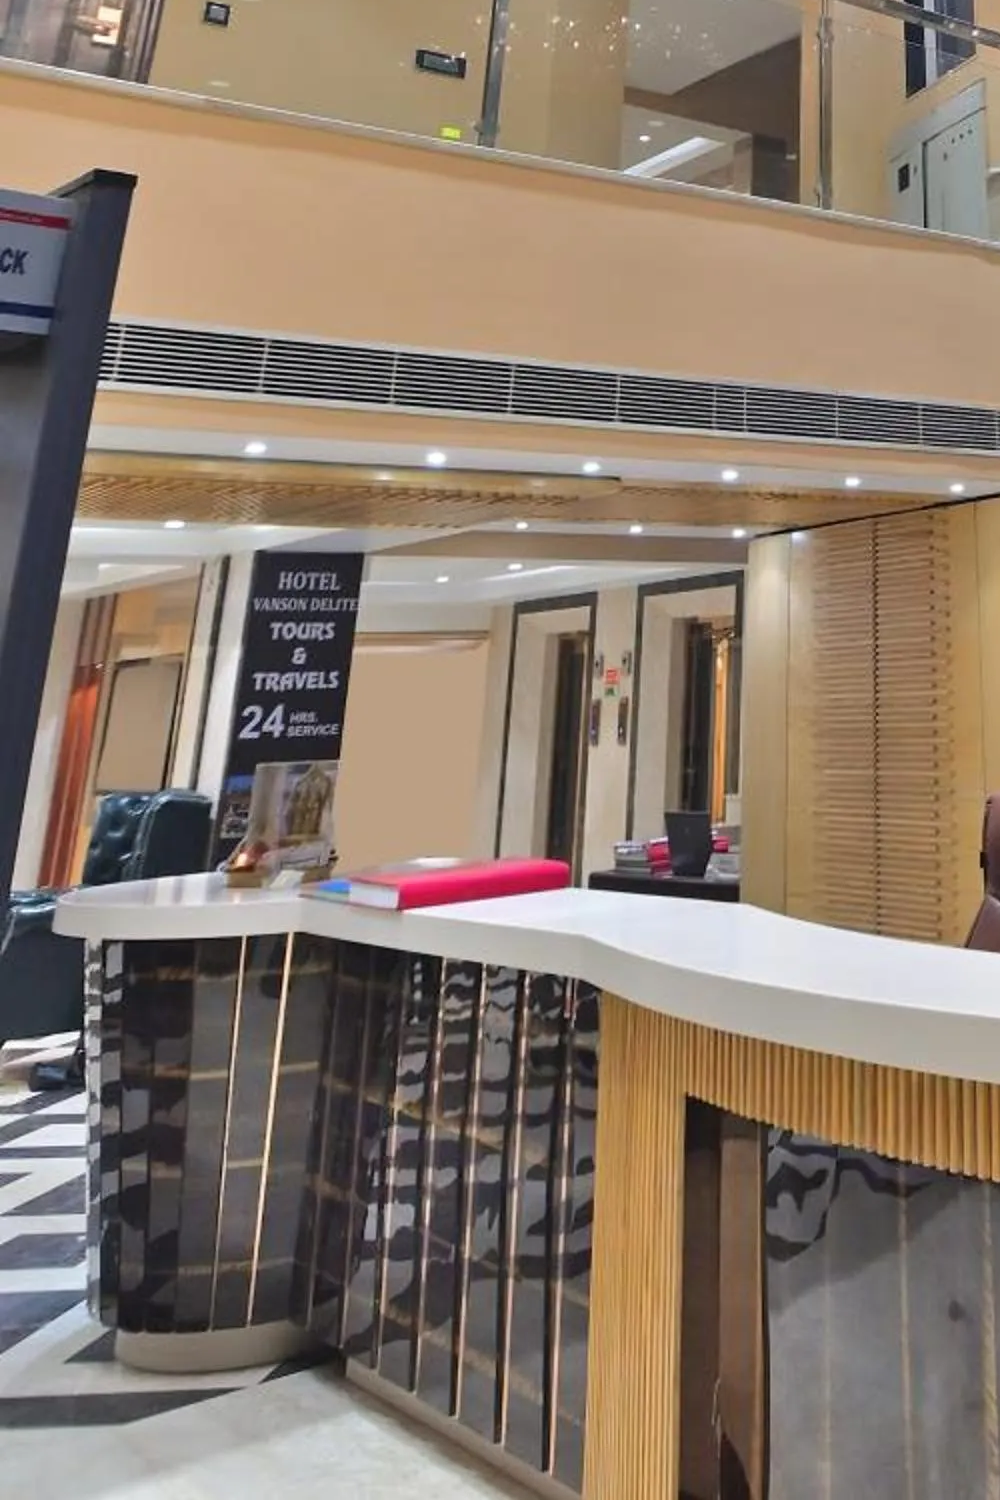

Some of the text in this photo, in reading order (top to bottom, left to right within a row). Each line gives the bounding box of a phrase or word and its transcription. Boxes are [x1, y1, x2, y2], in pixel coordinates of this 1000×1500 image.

[279, 571, 341, 591] HOTEL
[253, 597, 361, 612] VANSON DELITE
[269, 621, 336, 641] TOURS
[291, 647, 307, 665] &
[252, 670, 340, 692] TRAVELS
[238, 703, 286, 739] 24
[286, 723, 340, 737] SERVICE
